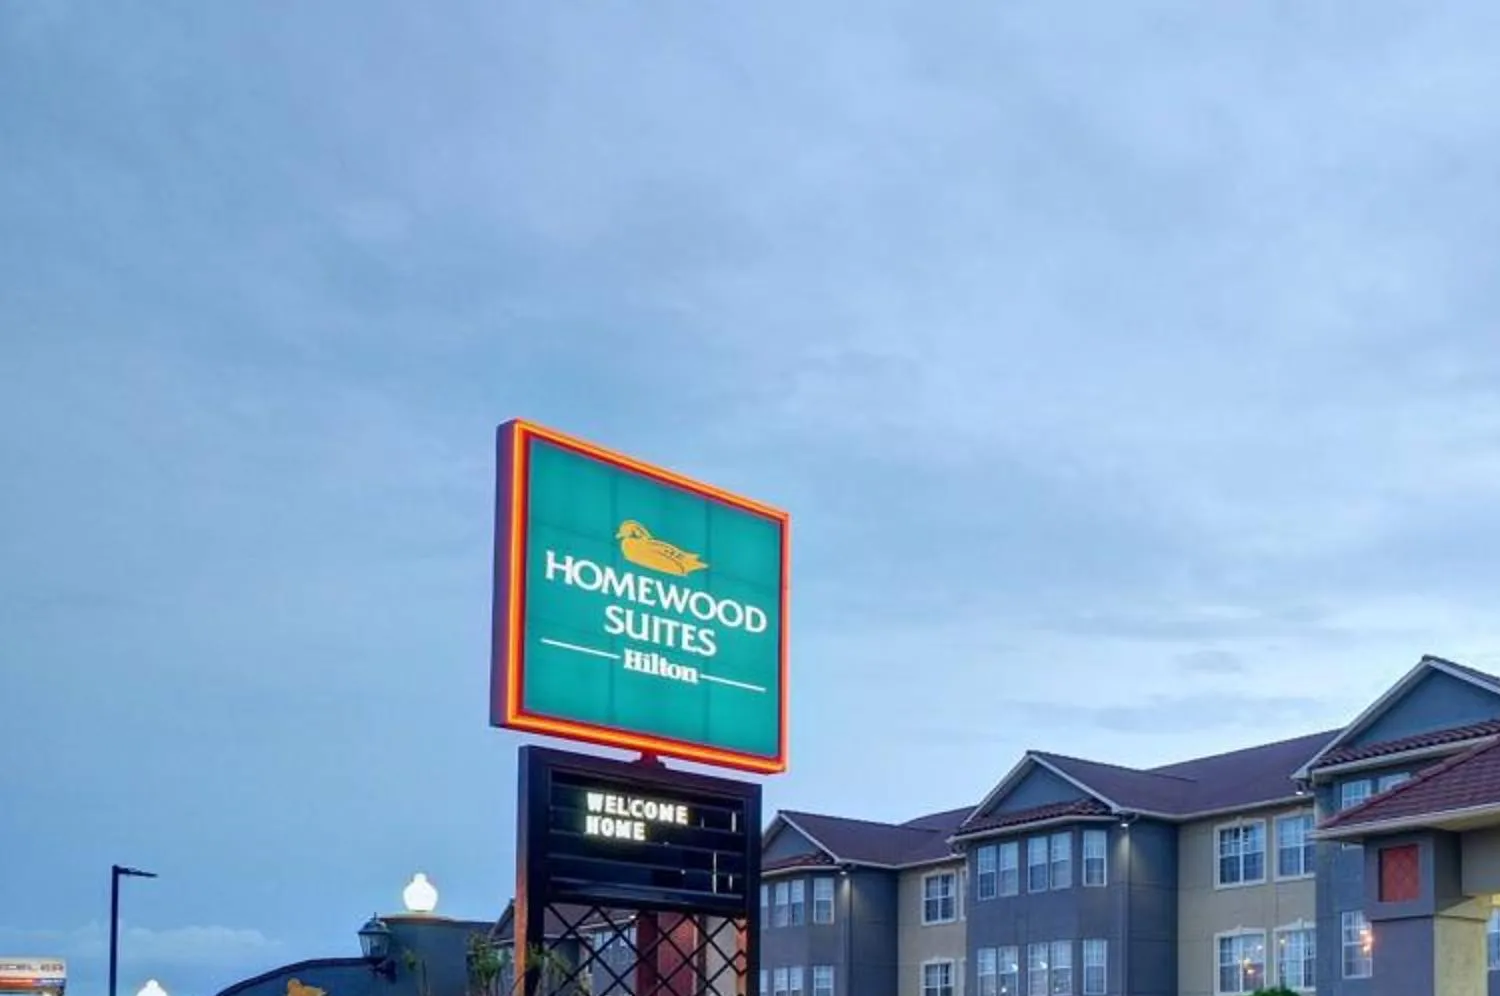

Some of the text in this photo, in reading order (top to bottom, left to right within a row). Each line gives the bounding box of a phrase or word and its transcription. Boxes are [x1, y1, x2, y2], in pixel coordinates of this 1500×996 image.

[545, 551, 767, 633] HOMEWOOD
[604, 605, 717, 656] SUITES
[623, 648, 698, 683] Hilton
[586, 792, 689, 825] WELCOME
[586, 816, 646, 841] HOME
